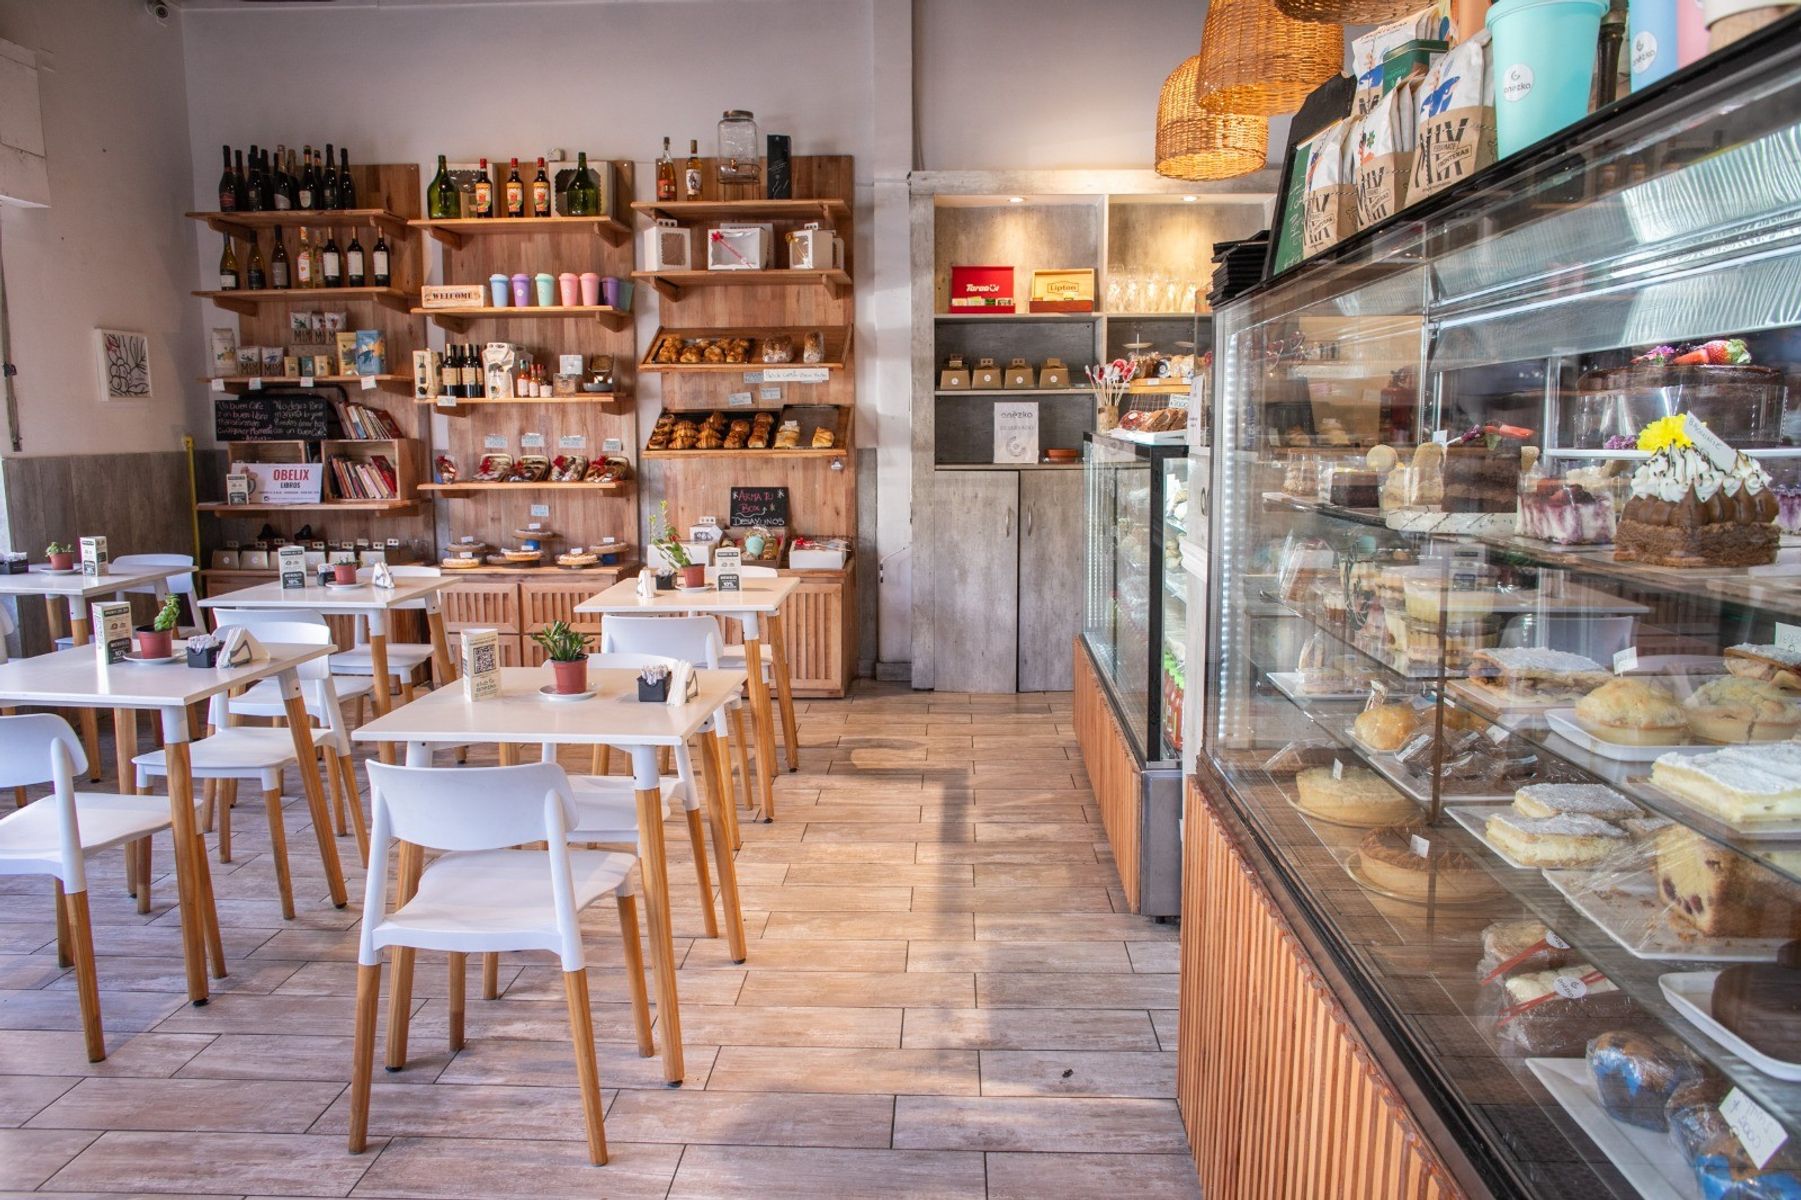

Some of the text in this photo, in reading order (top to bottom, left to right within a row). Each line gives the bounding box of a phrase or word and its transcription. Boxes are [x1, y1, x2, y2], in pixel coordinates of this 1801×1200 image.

[1050, 283, 1077, 293] Lipton
[432, 292, 473, 300] WELCOME
[273, 469, 310, 481] OBELIX
